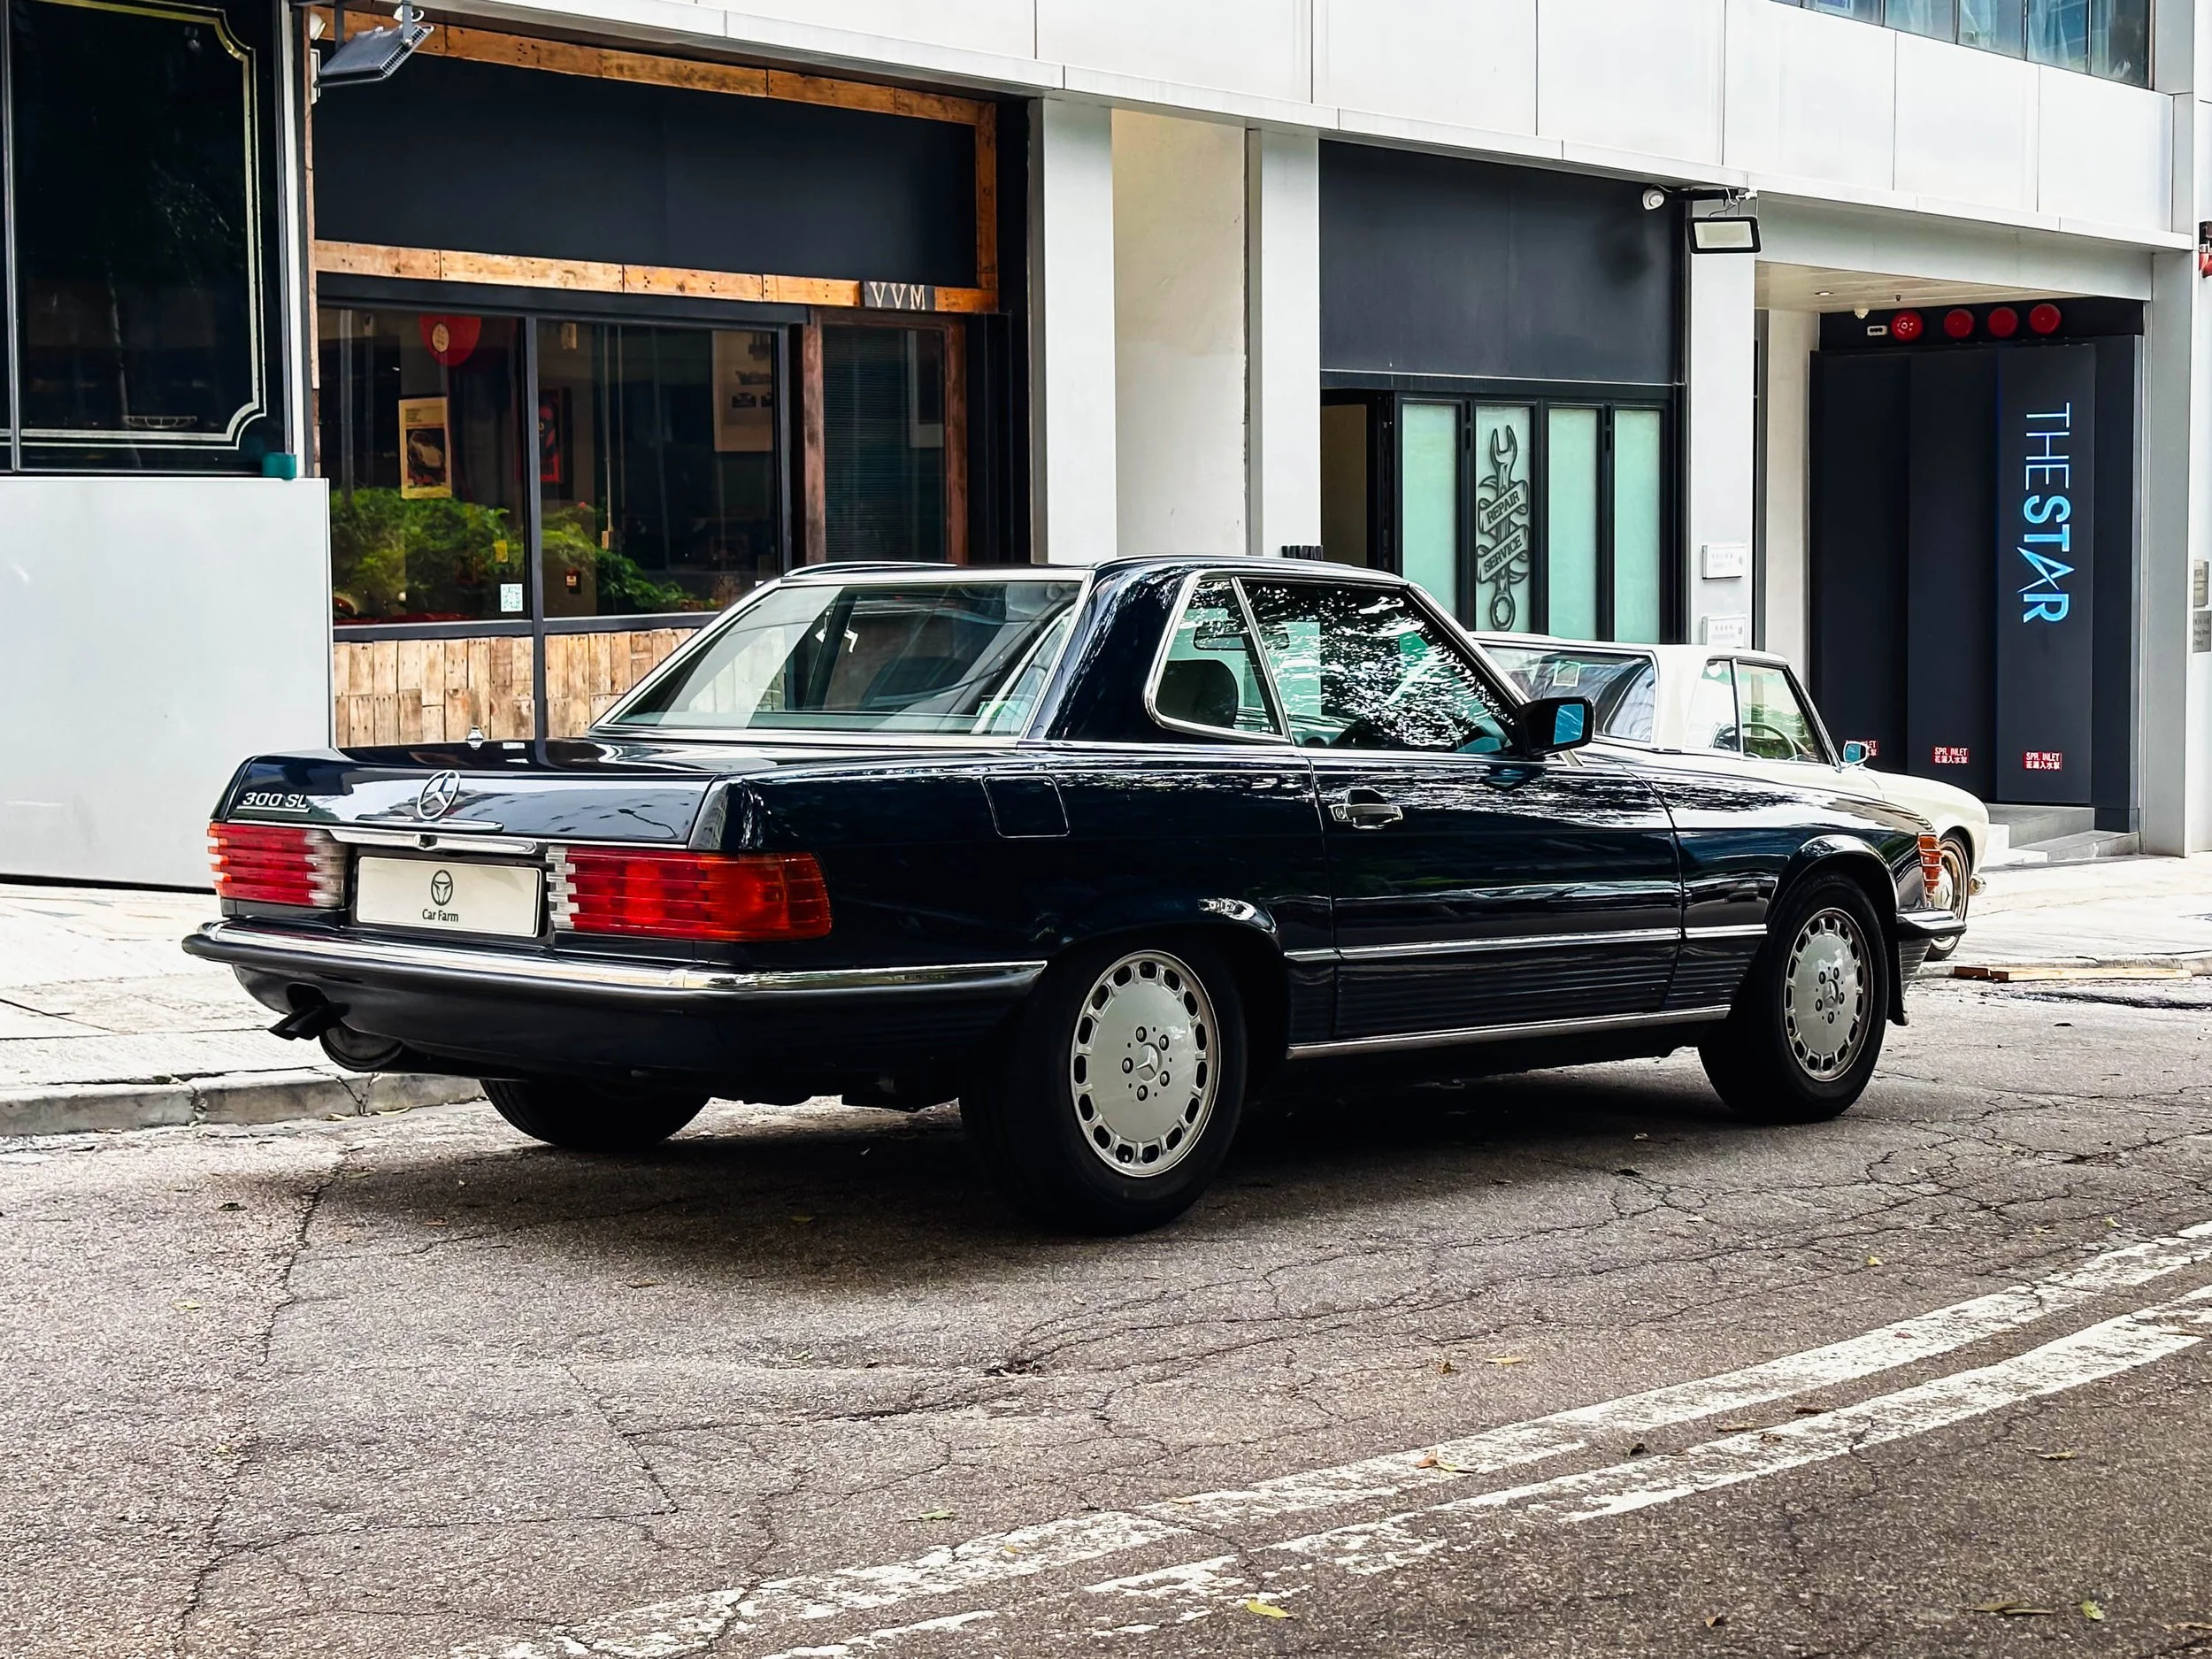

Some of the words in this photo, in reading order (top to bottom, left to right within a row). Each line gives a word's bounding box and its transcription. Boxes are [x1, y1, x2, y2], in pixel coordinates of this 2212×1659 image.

[870, 281, 926, 311] VVM
[1486, 490, 1520, 524] REPAIR
[1484, 534, 1522, 573] SERVICE
[1950, 747, 1968, 757] INLET
[2042, 752, 2060, 762] INLET
[242, 792, 283, 807] 300
[284, 794, 307, 808] SL
[422, 908, 437, 921] Car
[438, 910, 459, 923] Farm
